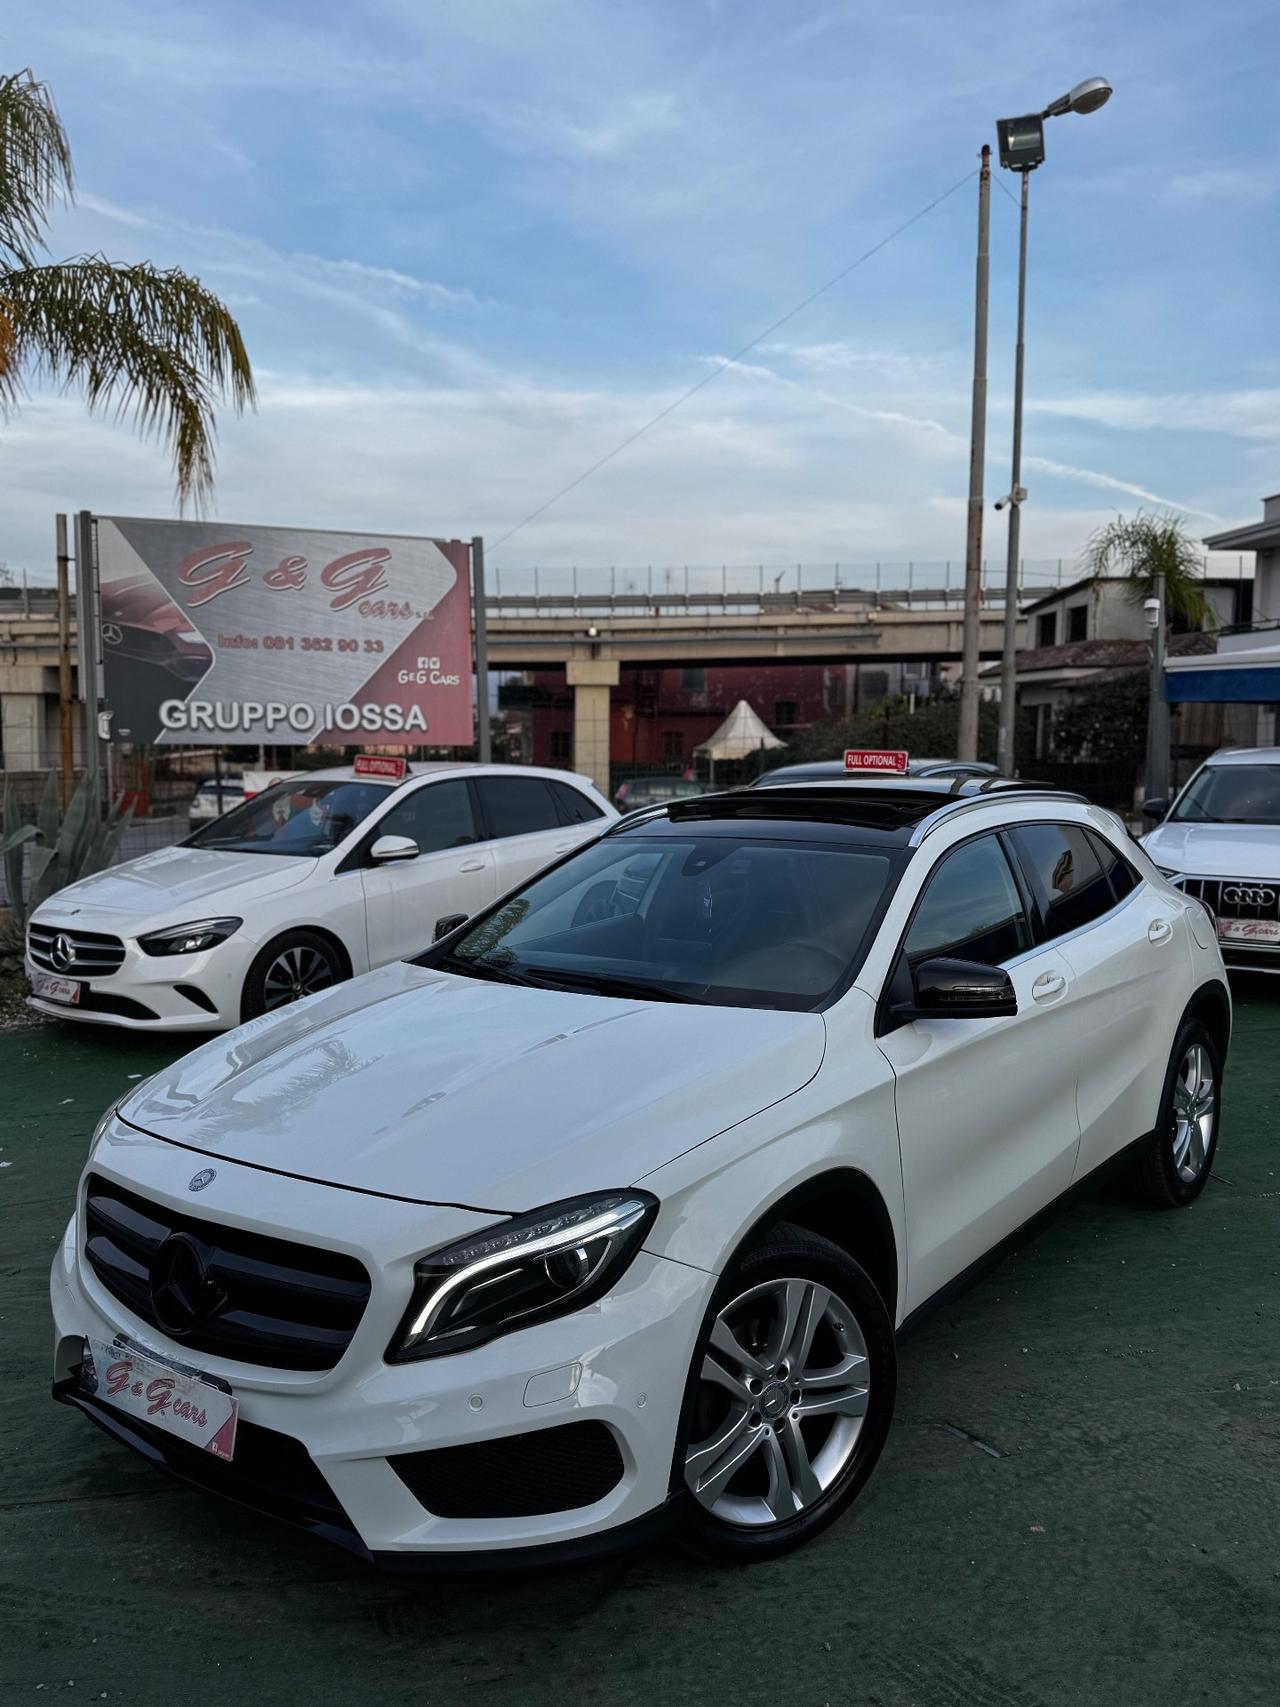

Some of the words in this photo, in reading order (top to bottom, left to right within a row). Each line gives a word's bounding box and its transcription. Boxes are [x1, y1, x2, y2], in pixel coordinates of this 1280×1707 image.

[363, 640, 384, 653] 33
[159, 700, 316, 731] GRUPPO
[324, 703, 428, 732] IOSSA
[848, 755, 862, 765] FULL
[863, 754, 896, 766] OPTIONAL
